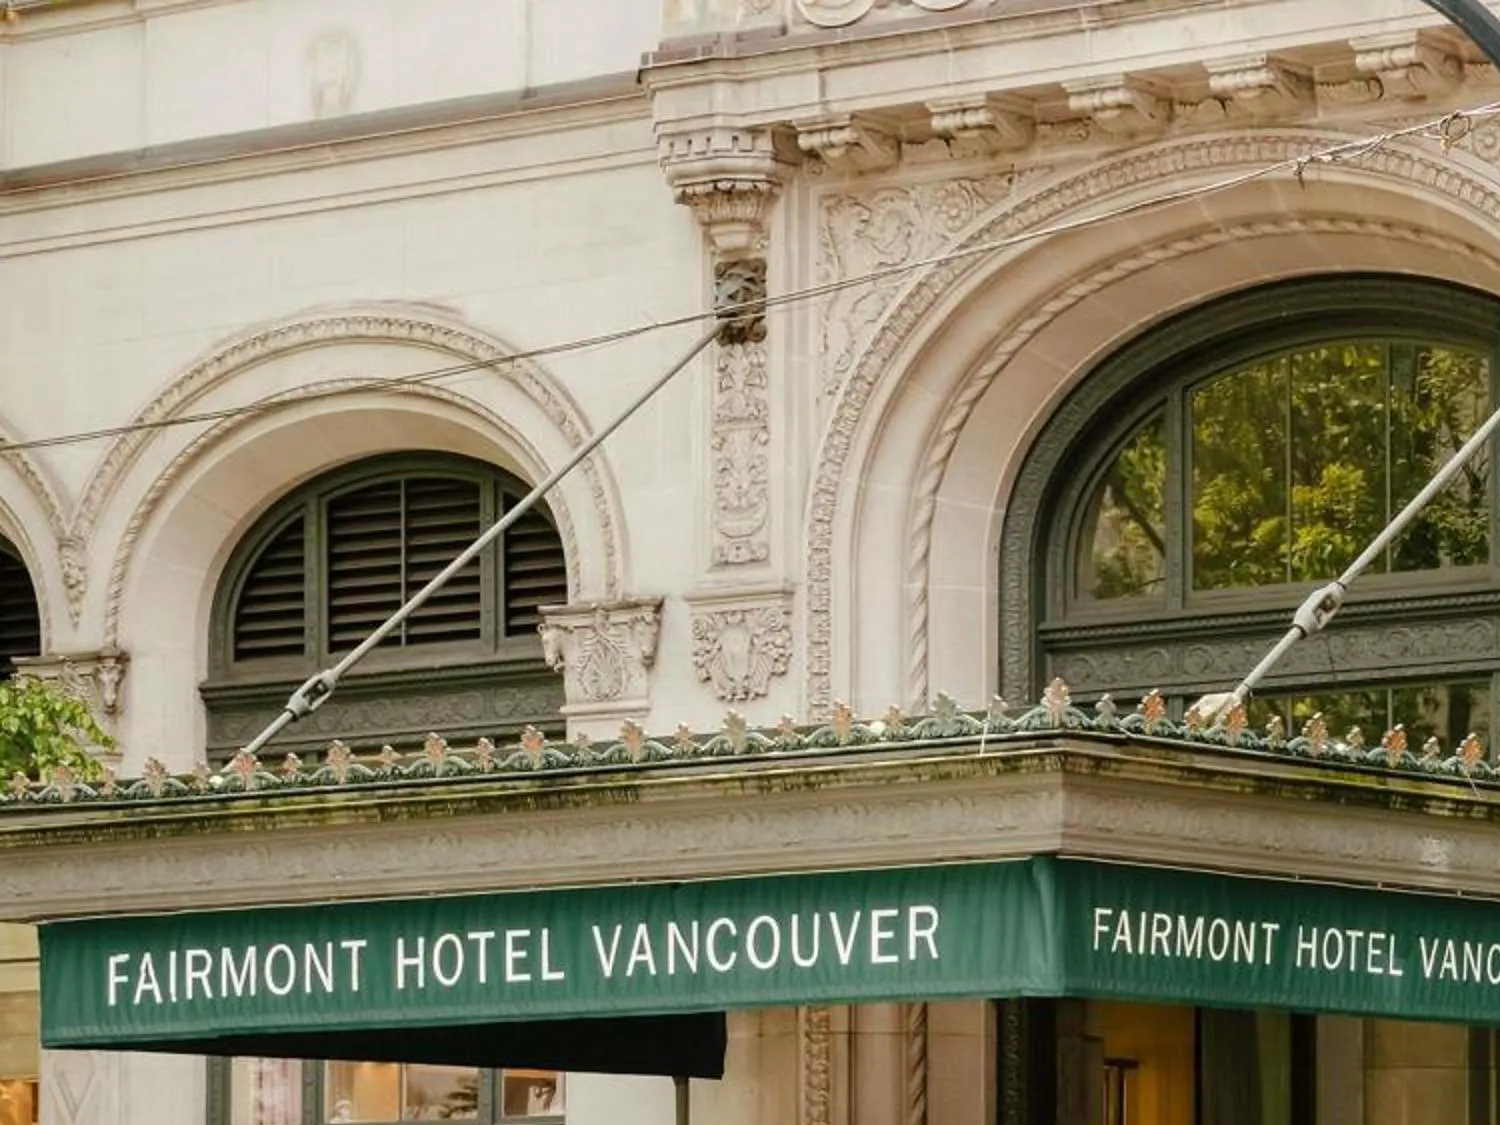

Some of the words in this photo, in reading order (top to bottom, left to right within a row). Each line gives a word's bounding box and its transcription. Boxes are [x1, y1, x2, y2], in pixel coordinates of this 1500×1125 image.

[107, 938, 367, 1007] FAIRMONT
[395, 928, 566, 990] HOTEL
[592, 905, 940, 979] VANCOUVER
[1093, 907, 1280, 965] FAIRMONT
[1295, 926, 1404, 977] HOTEL
